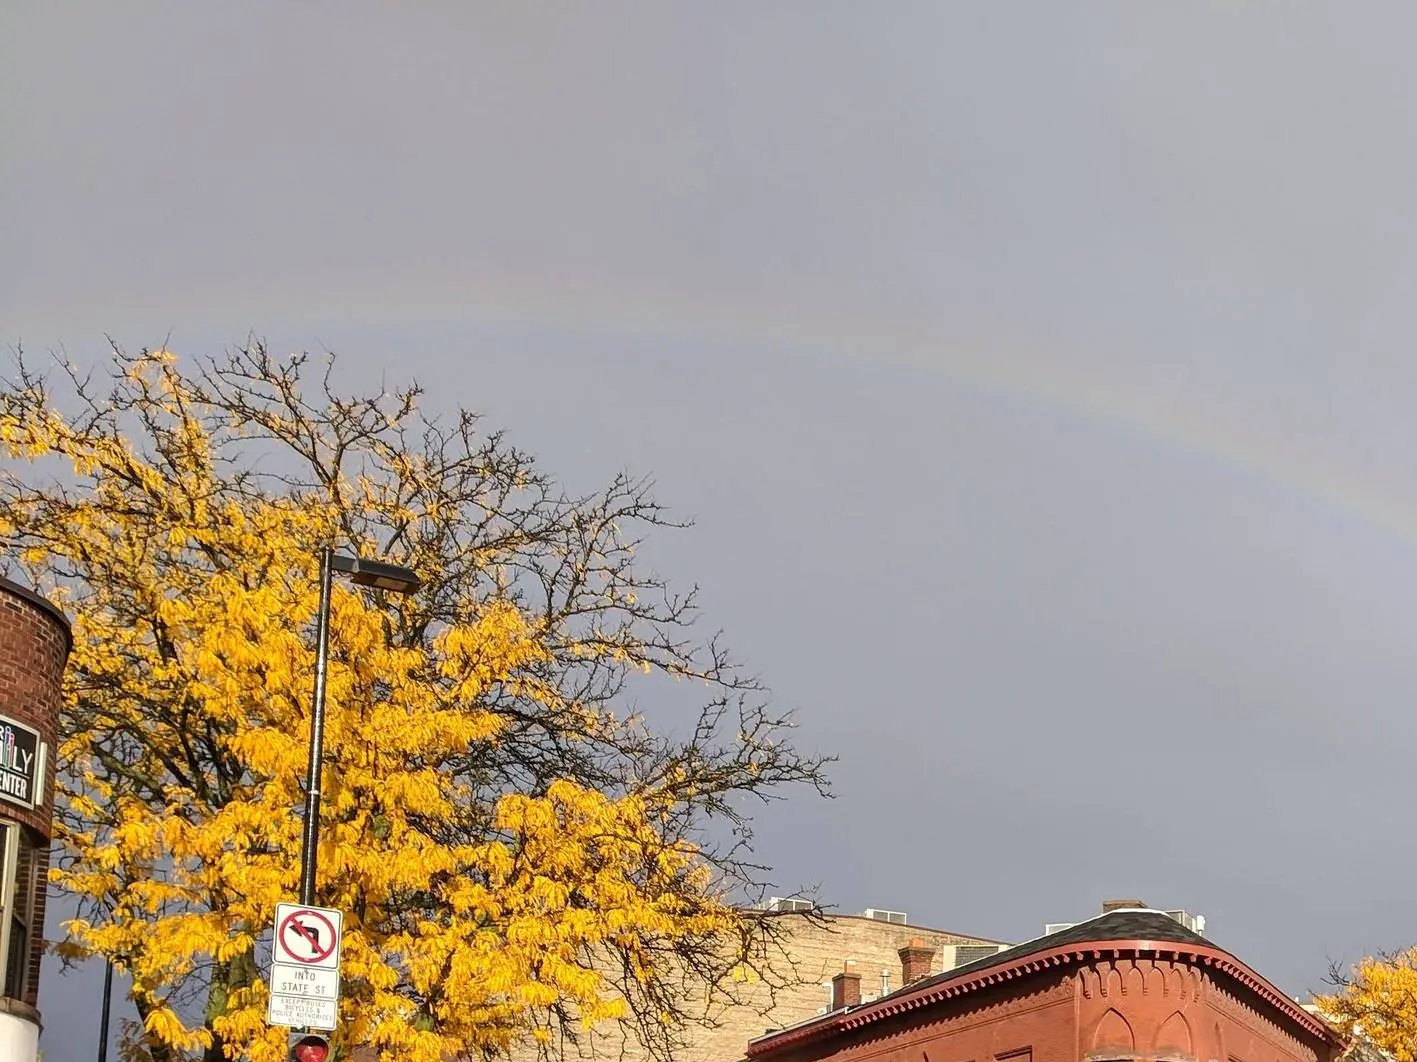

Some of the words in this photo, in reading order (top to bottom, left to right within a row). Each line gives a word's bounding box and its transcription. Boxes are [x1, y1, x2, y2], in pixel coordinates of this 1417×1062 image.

[294, 971, 316, 981] INTO
[281, 982, 309, 993] STATE
[315, 984, 326, 994] ST
